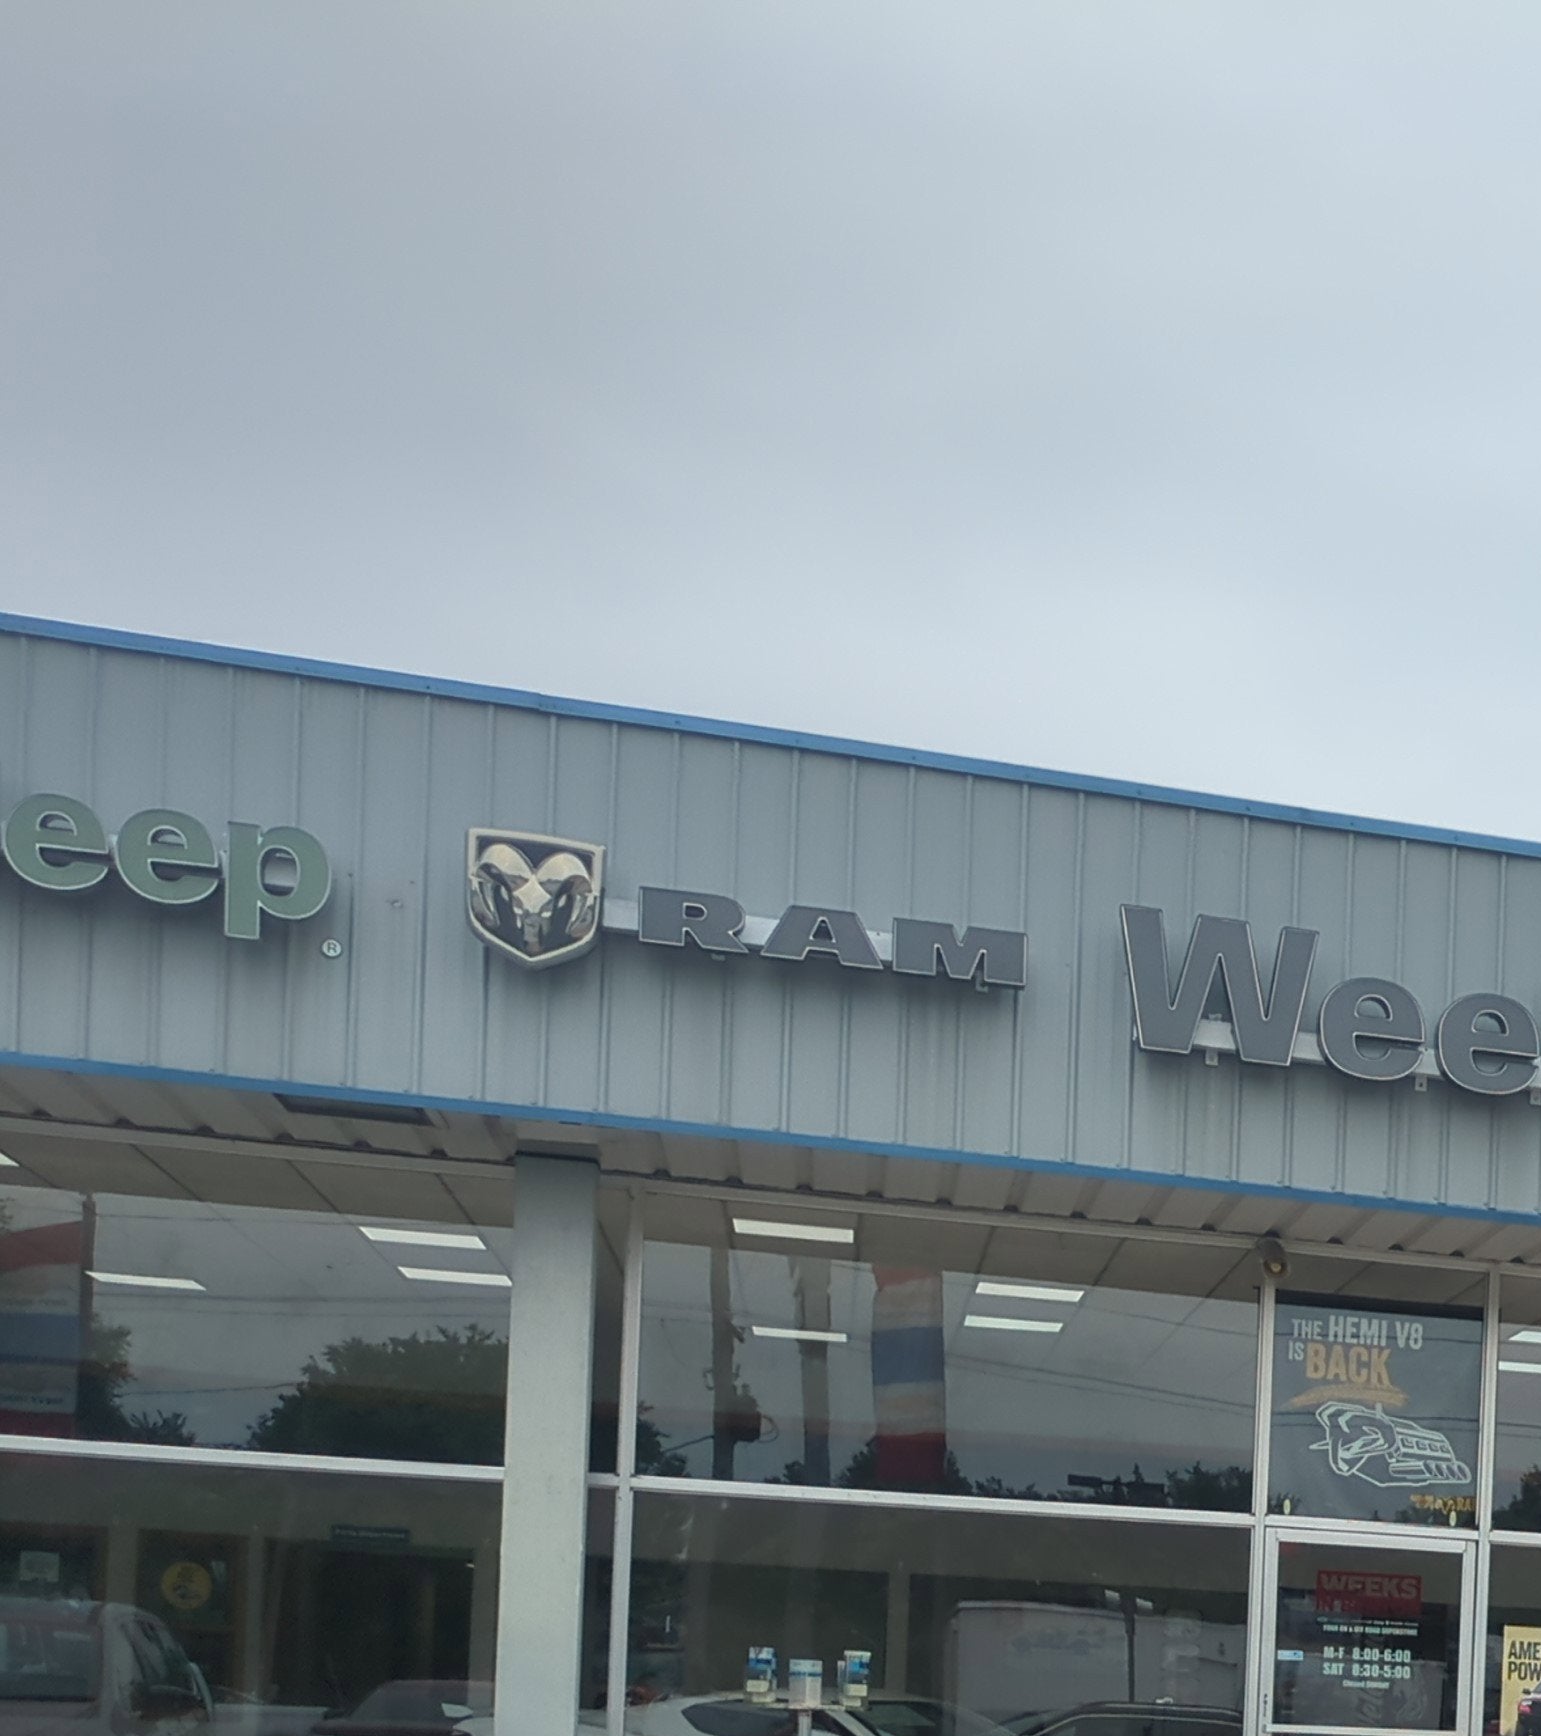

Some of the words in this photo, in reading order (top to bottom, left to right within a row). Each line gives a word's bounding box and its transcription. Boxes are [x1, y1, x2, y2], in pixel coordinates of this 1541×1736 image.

[638, 886, 1028, 987] RAM
[1291, 1318, 1324, 1340] THE
[1328, 1315, 1388, 1347] HEMI
[1395, 1321, 1424, 1350] V8
[1288, 1341, 1304, 1361] IS
[1305, 1342, 1394, 1388] BACK
[1319, 1572, 1418, 1599] WEEKS
[1323, 1646, 1345, 1659] M-F
[1323, 1663, 1345, 1675] SAT
